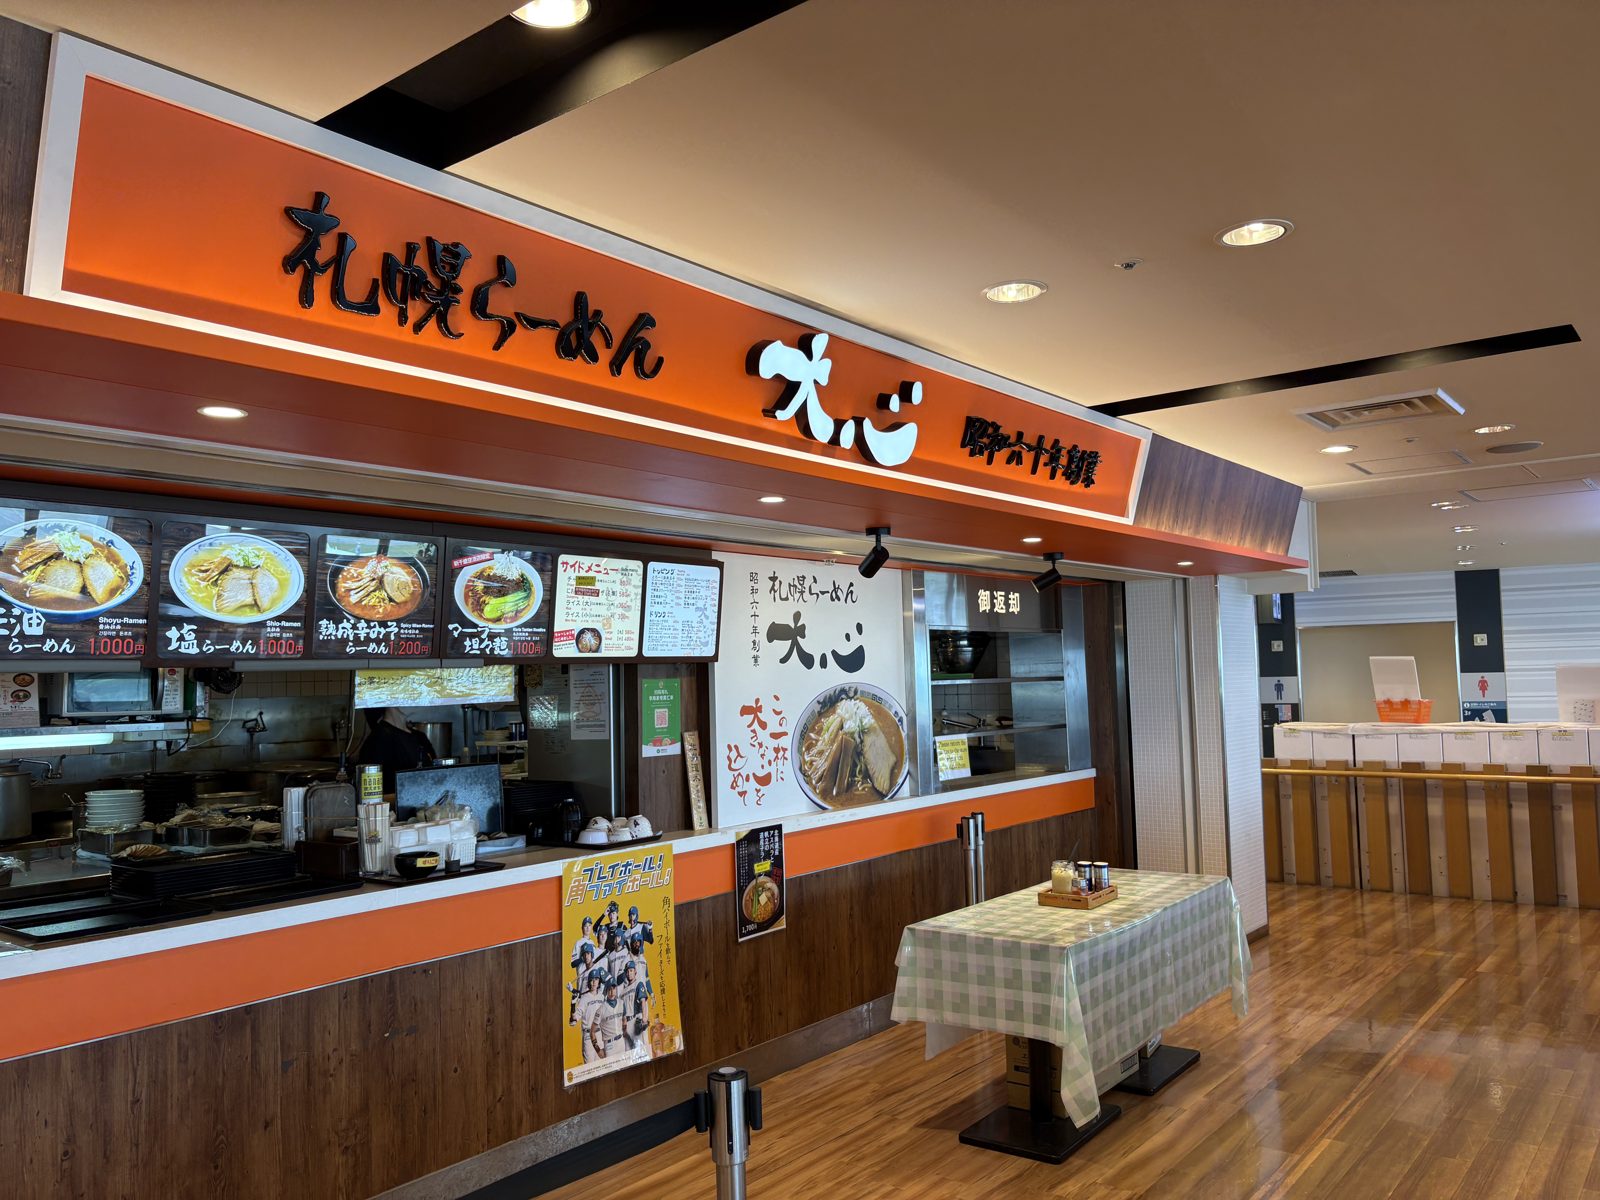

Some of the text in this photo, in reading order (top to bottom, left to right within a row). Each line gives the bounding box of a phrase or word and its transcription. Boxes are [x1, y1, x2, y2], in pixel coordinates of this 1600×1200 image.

[282, 191, 664, 380] 札幌らーめん
[560, 561, 619, 576] サイドメニュー
[767, 571, 858, 605] 札幌らーめん
[977, 588, 1021, 615] 御返却
[98, 616, 147, 625] Shoyu-Ramen
[318, 618, 399, 641] 熟成辛みそ
[447, 623, 506, 639] マーラー
[749, 571, 761, 668] 昭和六十年創業
[8, 638, 76, 654] らーめん
[89, 638, 145, 656] 1,000円
[165, 622, 257, 655] 塩 らーめん
[259, 639, 304, 656] 1,000円
[346, 642, 389, 655] らーめん
[389, 641, 430, 656] 1,200円
[769, 694, 789, 783] この一杯に
[739, 697, 773, 807] 大きな心を
[726, 743, 752, 807] 込めて
[581, 852, 664, 884] プレイボール!
